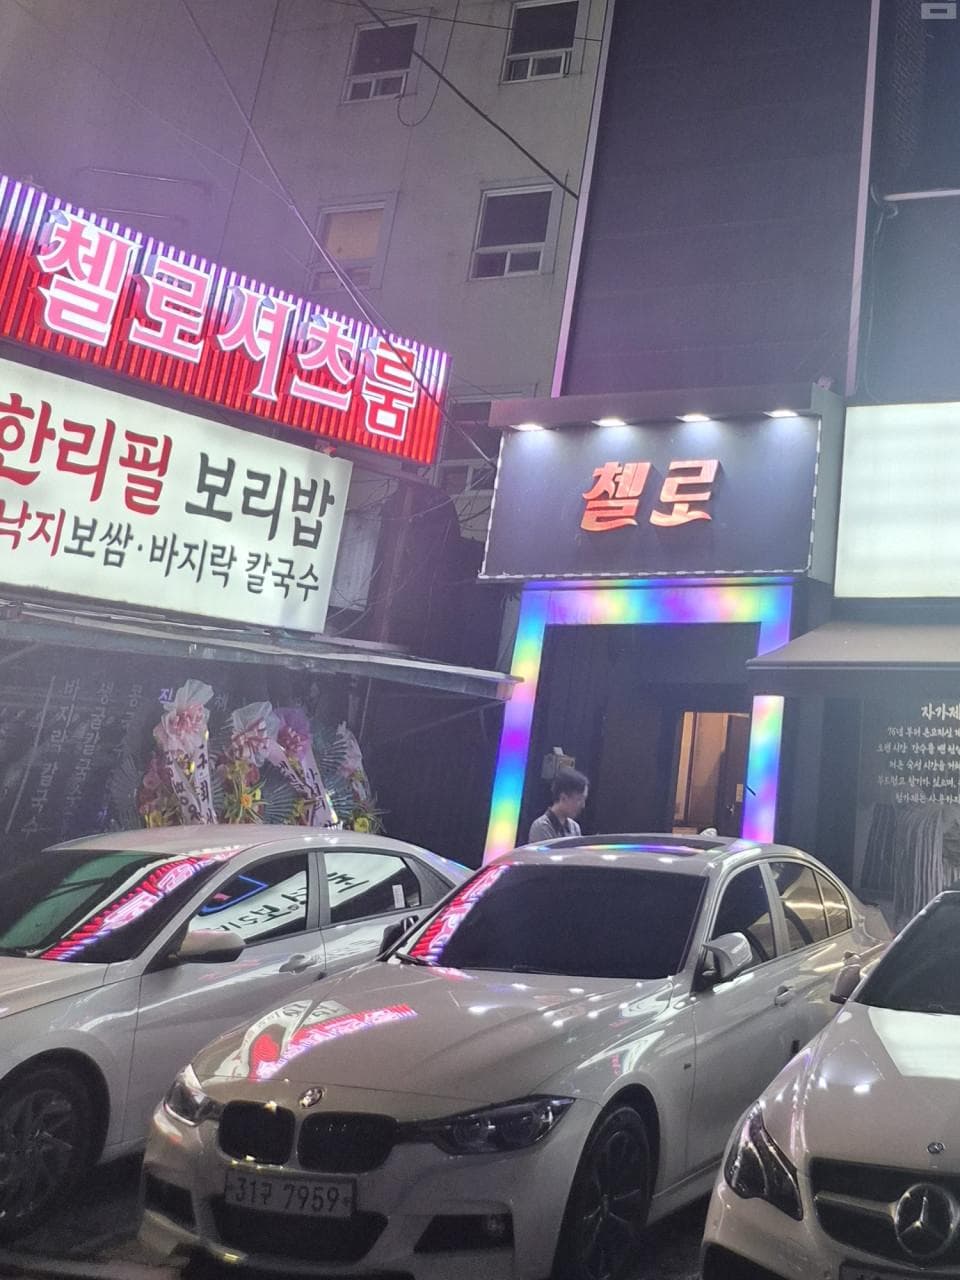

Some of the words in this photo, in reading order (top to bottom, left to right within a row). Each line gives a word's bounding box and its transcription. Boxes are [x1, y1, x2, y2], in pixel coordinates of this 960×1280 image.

[36, 210, 418, 442] 첼로셔츠룸
[185, 451, 335, 550] 보리밥
[580, 459, 720, 532] 첼로
[245, 550, 320, 602] 칼국수
[283, 1183, 340, 1213] 7959
